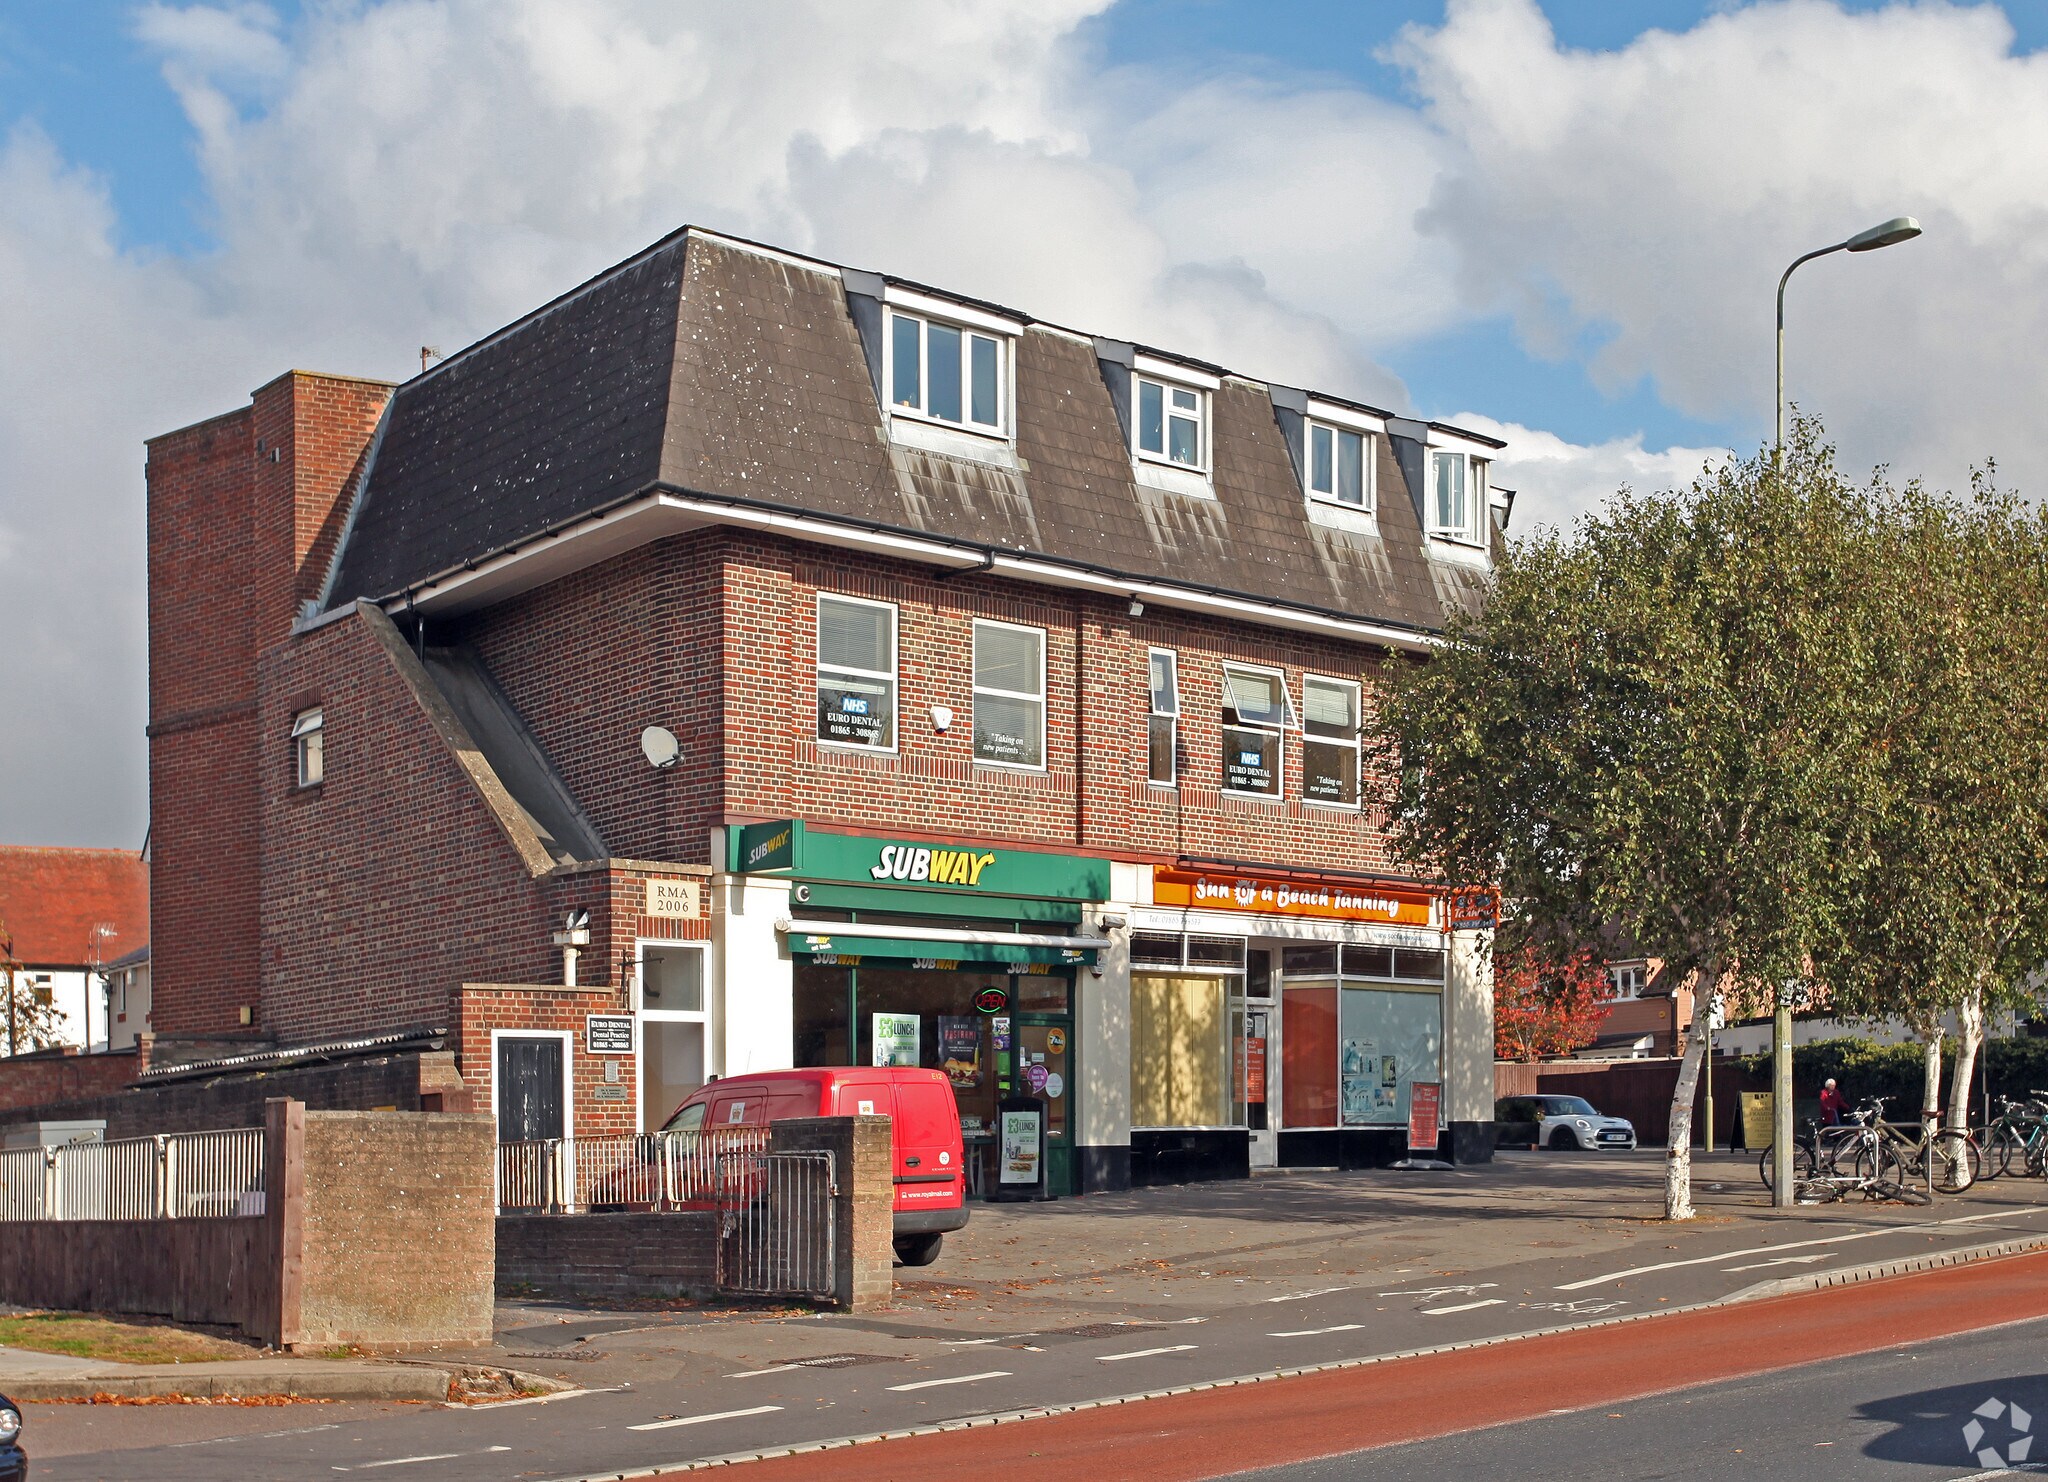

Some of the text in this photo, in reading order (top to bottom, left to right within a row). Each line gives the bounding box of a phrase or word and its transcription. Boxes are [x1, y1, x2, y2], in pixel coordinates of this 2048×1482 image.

[843, 698, 867, 713] NHS
[827, 712, 883, 727] EURO DENTAL
[830, 724, 850, 735] 01865
[855, 727, 880, 739] 308865
[1241, 752, 1260, 766] NHS
[1228, 764, 1272, 778] EURO DENTAL
[1231, 775, 1247, 785] 01865
[1250, 777, 1270, 788] 308865
[748, 829, 790, 865] SUBWAY
[870, 844, 996, 886] SUBWAY
[656, 885, 689, 899] RMA
[1195, 878, 1230, 900] Sun
[1260, 886, 1274, 902] a
[1276, 884, 1329, 908] Beach
[1333, 889, 1400, 918] Tanning
[657, 899, 689, 913] 2006
[812, 953, 862, 966] SUBWAY
[912, 957, 961, 970] SUBWAY
[1007, 962, 1051, 974] SUBWAY
[975, 994, 1007, 1008] OPEN
[608, 1021, 631, 1029] DENTAL
[879, 1017, 915, 1038] £3 LUNCH
[1007, 1118, 1036, 1134] £3 LUNCH
